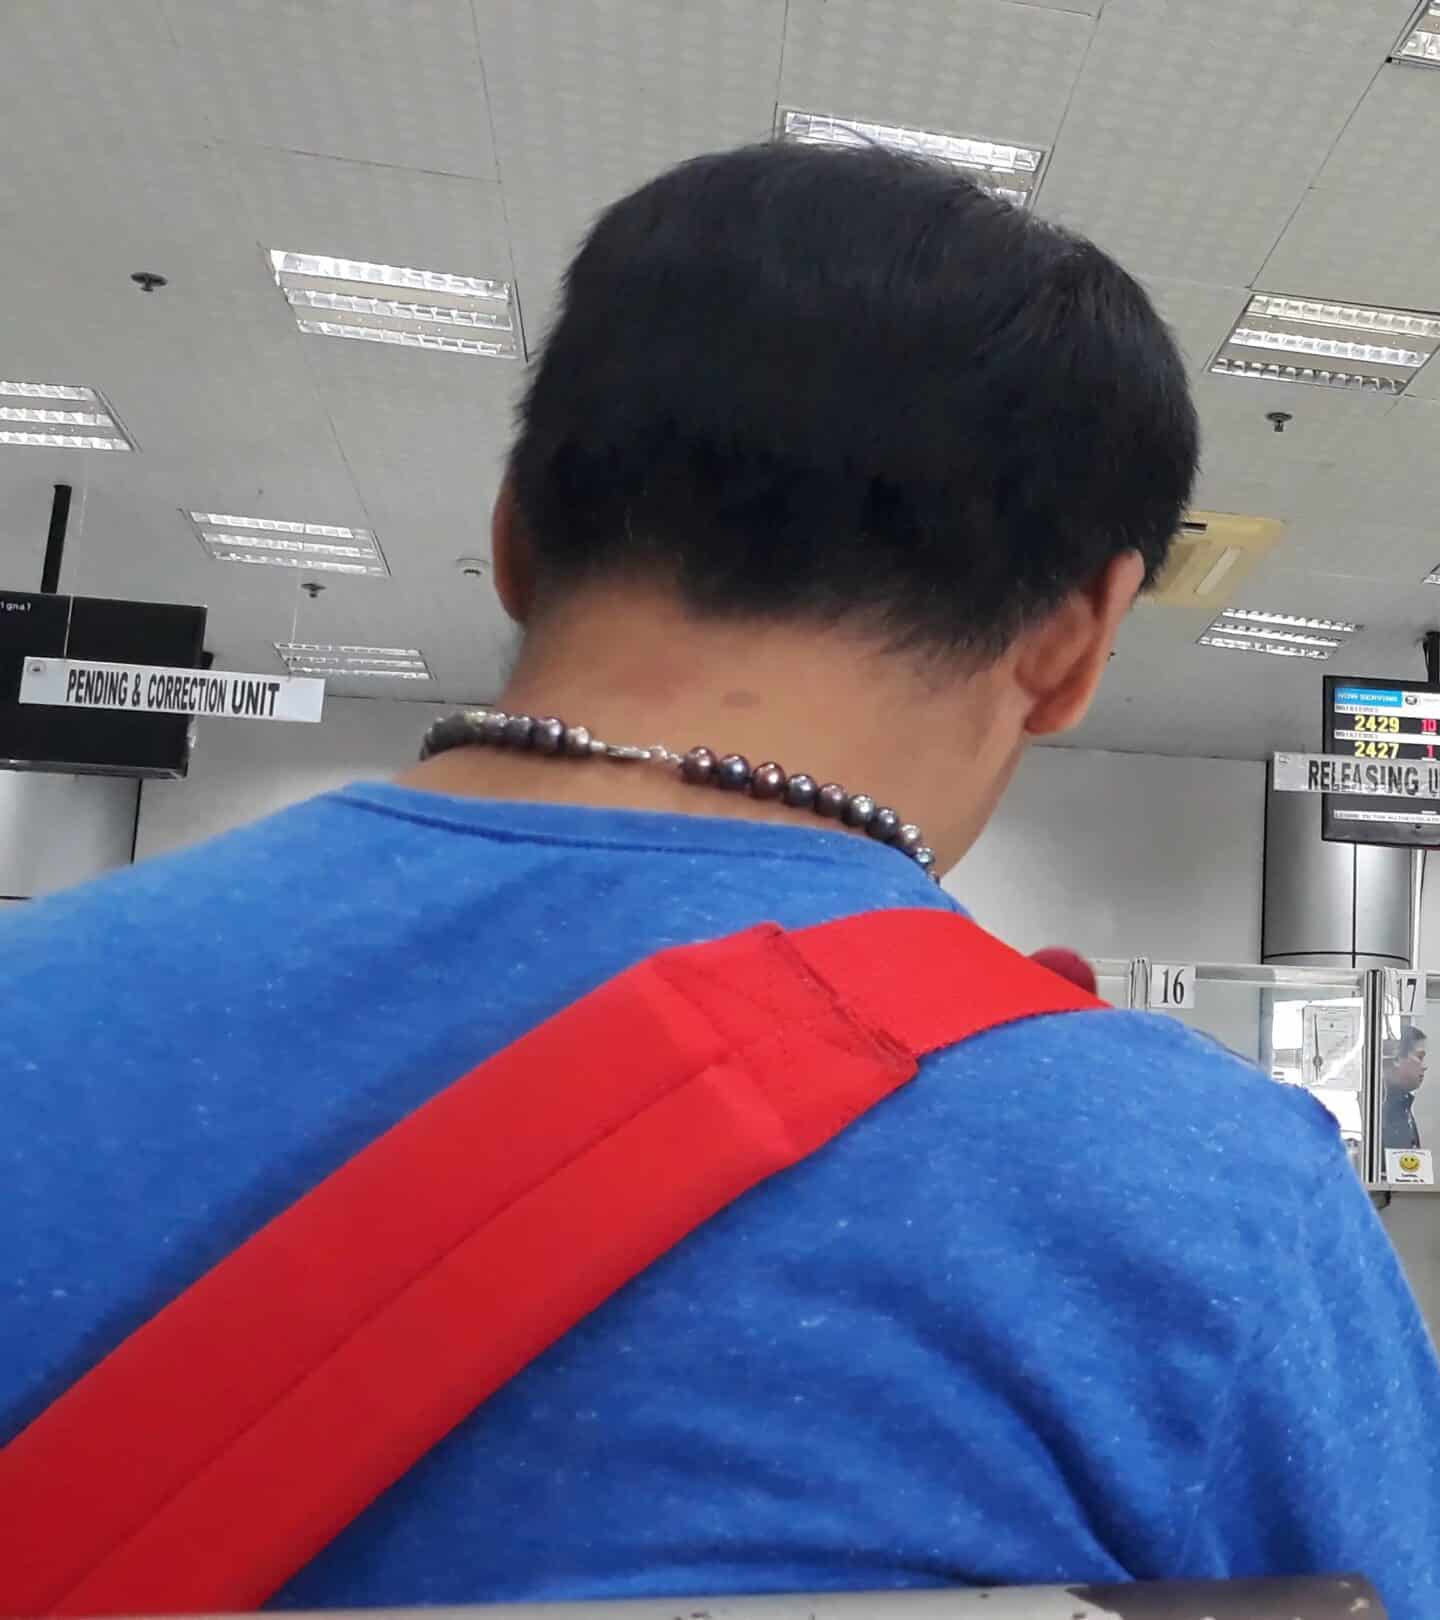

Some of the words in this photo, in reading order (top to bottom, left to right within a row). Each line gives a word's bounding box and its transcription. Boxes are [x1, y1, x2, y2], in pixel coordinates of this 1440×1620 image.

[67, 669, 128, 705] PENDING
[132, 673, 141, 706] &
[147, 674, 227, 712] CORRECTION
[231, 680, 280, 716] UNIT
[1355, 715, 1400, 732] 2429
[1422, 718, 1437, 732] 10
[1355, 741, 1400, 759] 2427
[1426, 744, 1434, 758] 1
[1308, 760, 1419, 795] RELEASING
[1163, 968, 1185, 1005] 16
